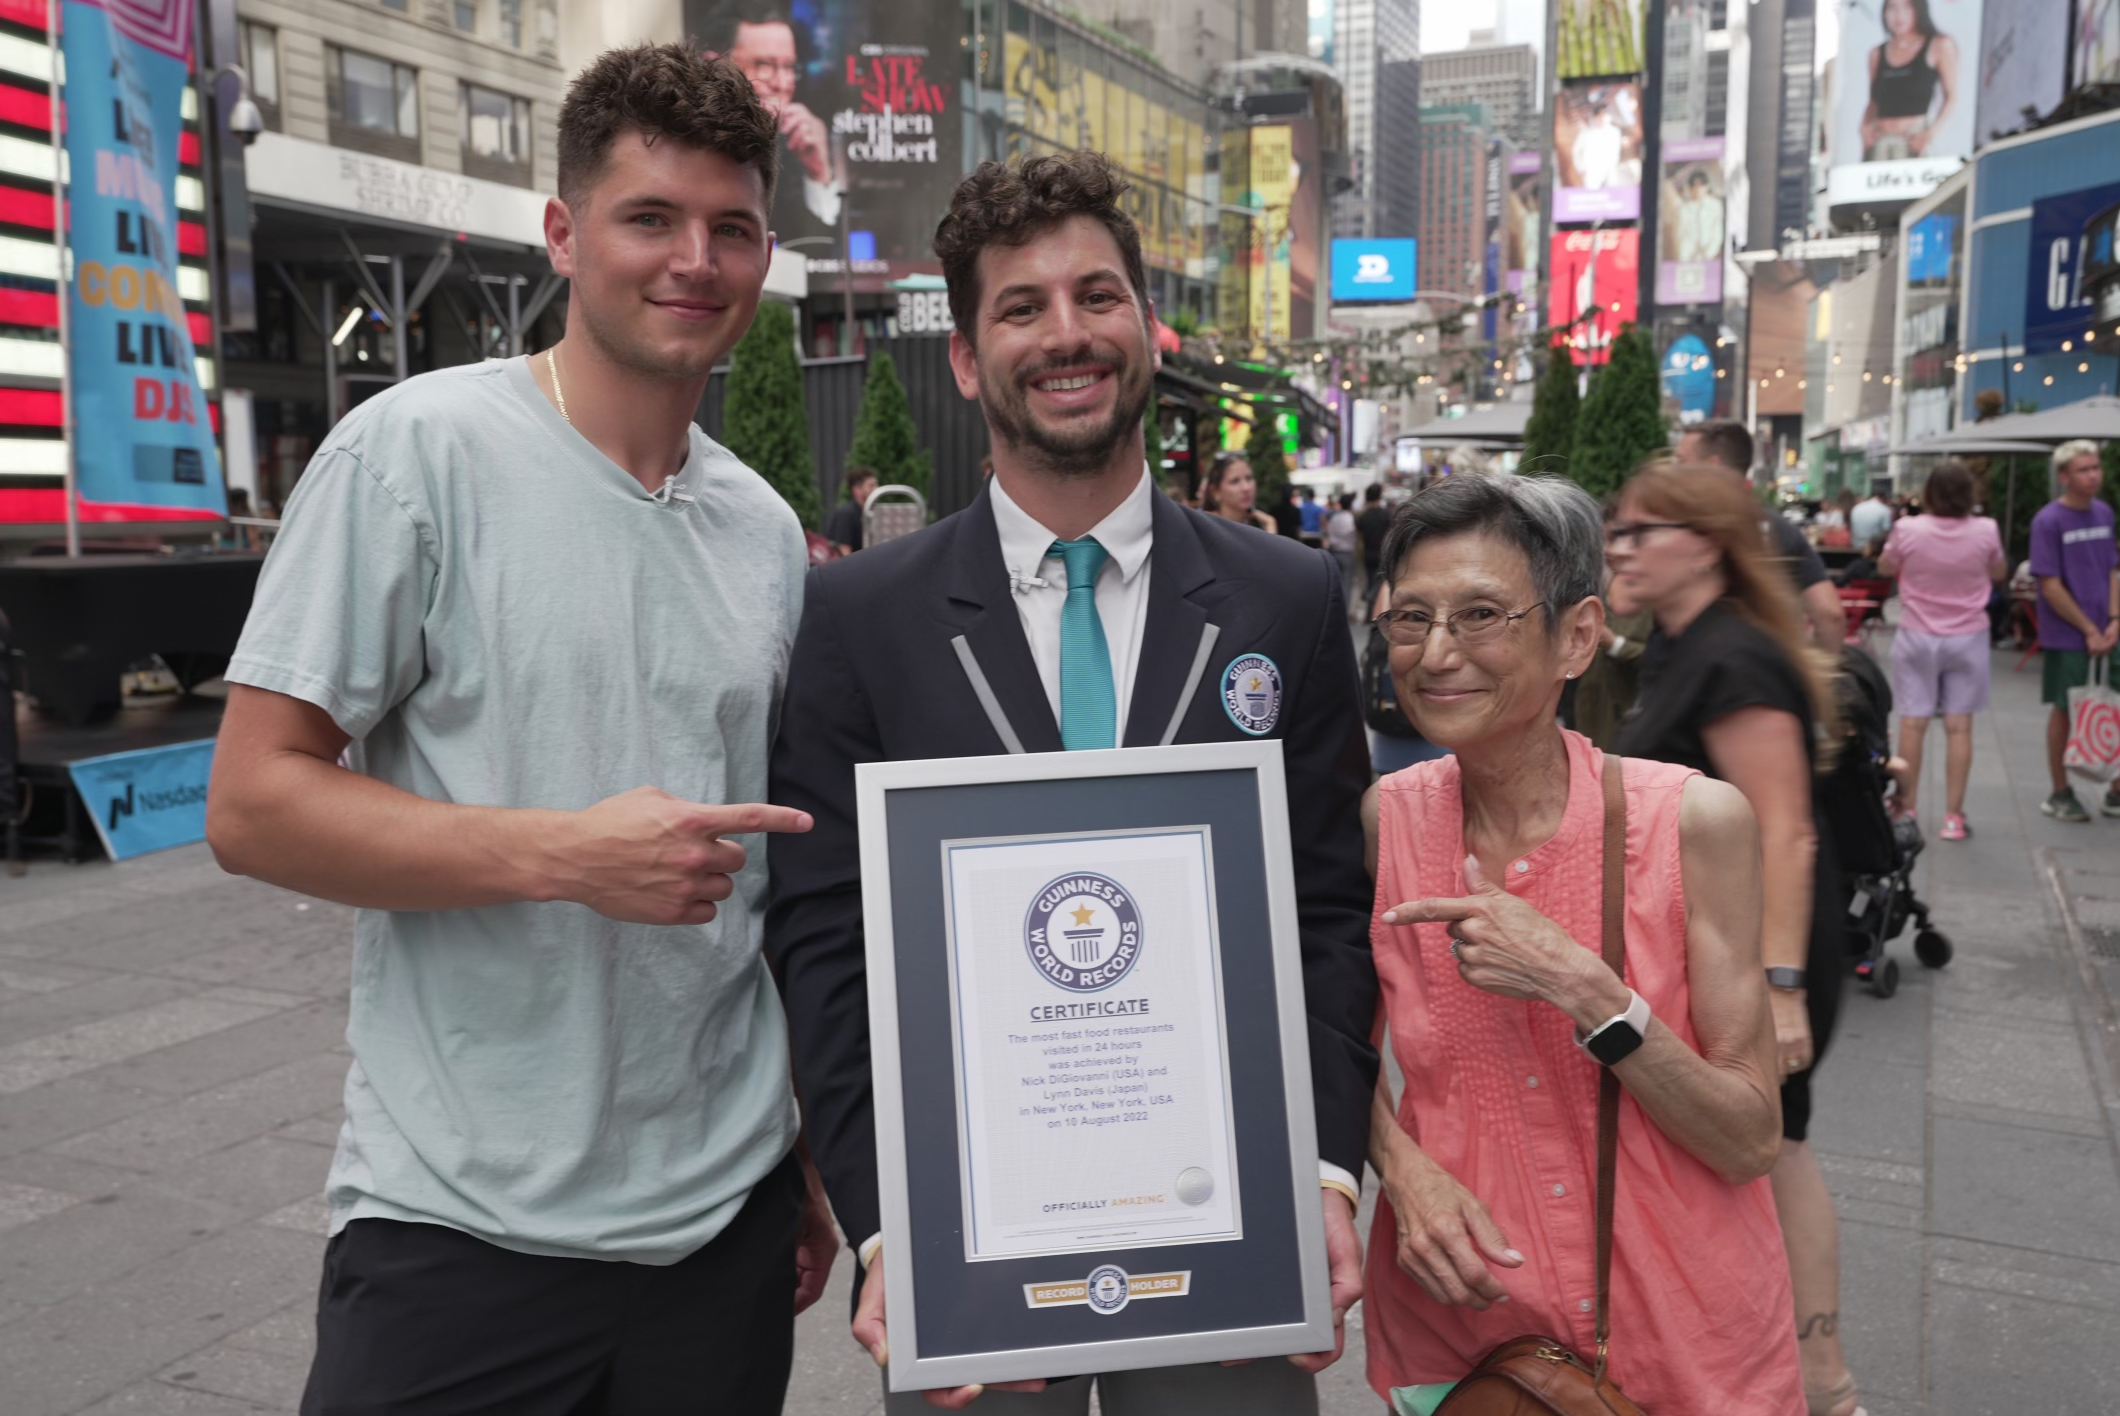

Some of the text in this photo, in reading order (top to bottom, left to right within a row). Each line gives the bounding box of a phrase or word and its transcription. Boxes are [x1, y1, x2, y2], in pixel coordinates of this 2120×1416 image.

[832, 103, 933, 143] stephen
[848, 126, 938, 163] colbert
[913, 291, 956, 332] BEE
[1229, 659, 1277, 681] GUINNESS
[1226, 689, 1252, 728] WORLD
[1038, 879, 1125, 913] GUINNESS
[1030, 921, 1137, 986] WORLD RECORDS
[1030, 999, 1149, 1020] CERTIFICATE
[1008, 1023, 1174, 1044] The most fast food restaurants
[1042, 1039, 1142, 1056] visited in 24 hours
[1049, 1055, 1138, 1070] was achieved by
[1022, 1066, 1167, 1086] Nick DiGiovanni (USA) and
[1044, 1082, 1148, 1102] Lynn Davis (Japan)
[1019, 1106, 1030, 1116] in
[1033, 1104, 1056, 1114] New
[1060, 1102, 1088, 1114] York,
[1092, 1100, 1114, 1110] New
[1150, 1094, 1173, 1105] USA
[1047, 1112, 1148, 1128] on 10 August 2022
[1043, 1195, 1164, 1213] OFFICIALLY AMAZING
[1036, 1278, 1178, 1300] RECORD HOLDER
